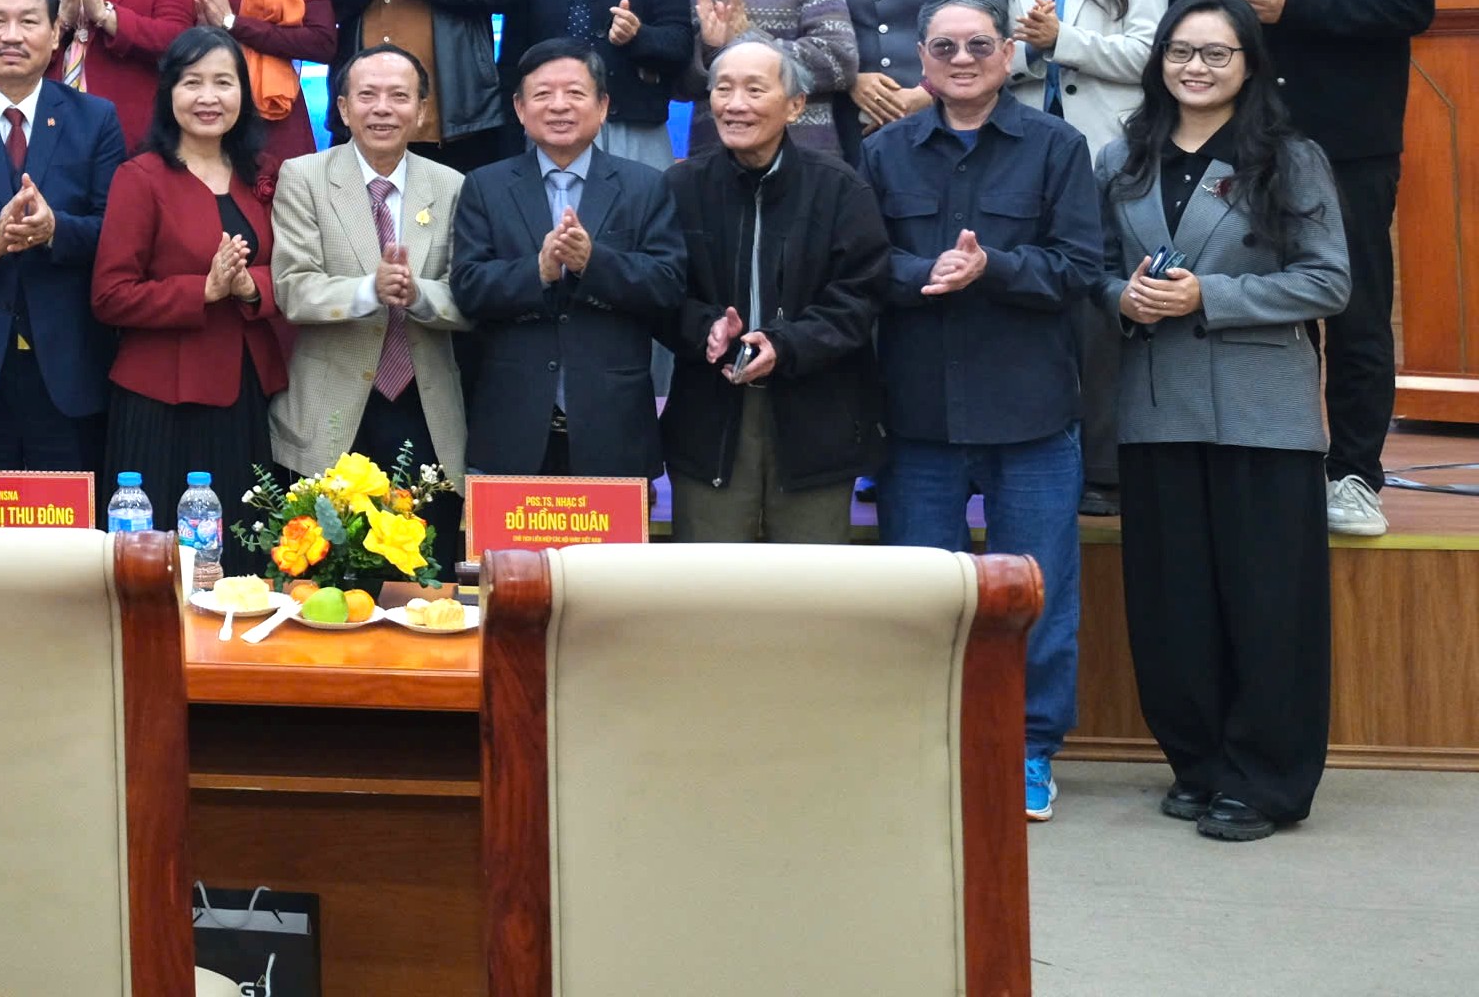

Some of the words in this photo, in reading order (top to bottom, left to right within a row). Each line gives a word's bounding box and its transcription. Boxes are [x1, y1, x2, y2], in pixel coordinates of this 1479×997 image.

[7, 506, 34, 524] THU
[37, 503, 74, 525] ĐÔNG
[555, 497, 577, 509] NHẠC
[505, 506, 524, 530] ĐỖ
[528, 507, 567, 531] HỒNG
[570, 510, 609, 532] QUÂN
